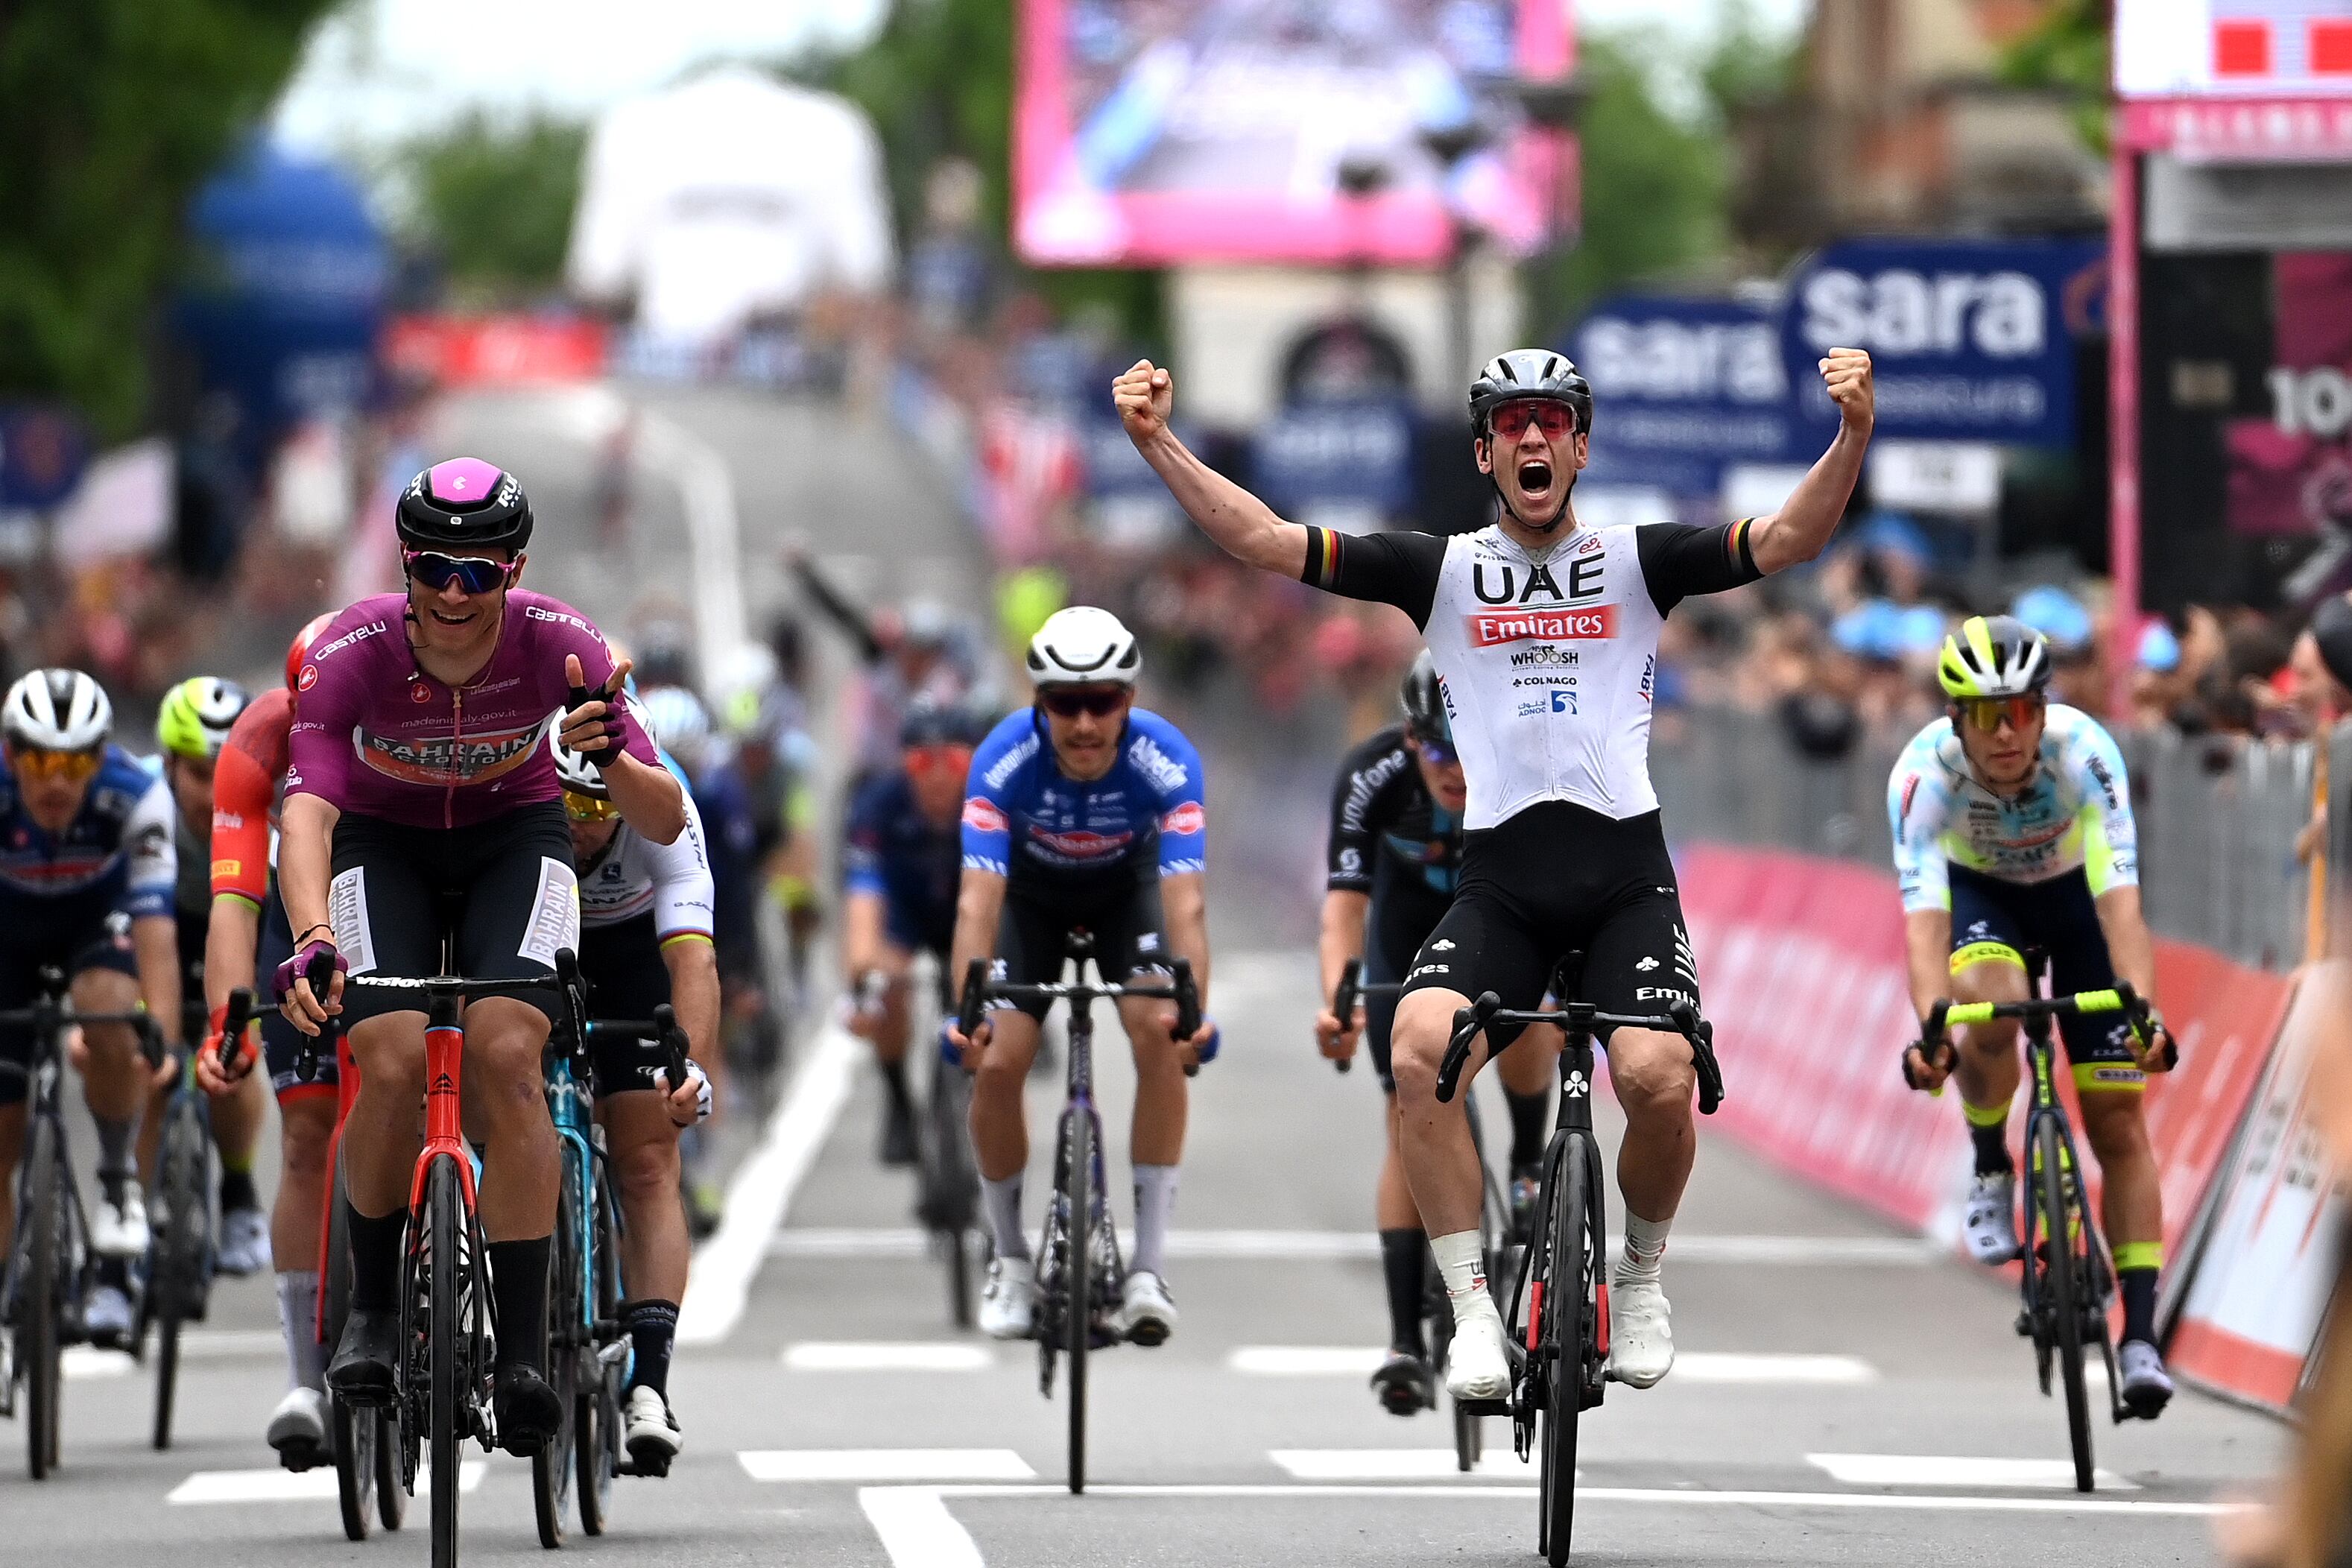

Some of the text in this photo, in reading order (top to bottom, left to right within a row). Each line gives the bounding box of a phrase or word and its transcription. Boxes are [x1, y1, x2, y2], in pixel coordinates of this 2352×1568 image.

[1803, 269, 2047, 355] sara
[1579, 317, 1783, 400] sara
[1473, 551, 1606, 604] UAE
[1479, 615, 1603, 642] Emirates
[1510, 651, 1578, 666] WHOOSH
[1641, 653, 1654, 691] FAB
[1524, 677, 1578, 686] COLNAGO
[1441, 683, 1457, 720] FAB
[1519, 706, 1546, 718] ADNOC
[373, 733, 531, 759] BAHRAIN
[338, 874, 362, 952] BAHRAIN
[530, 879, 568, 958] BAHRAIN
